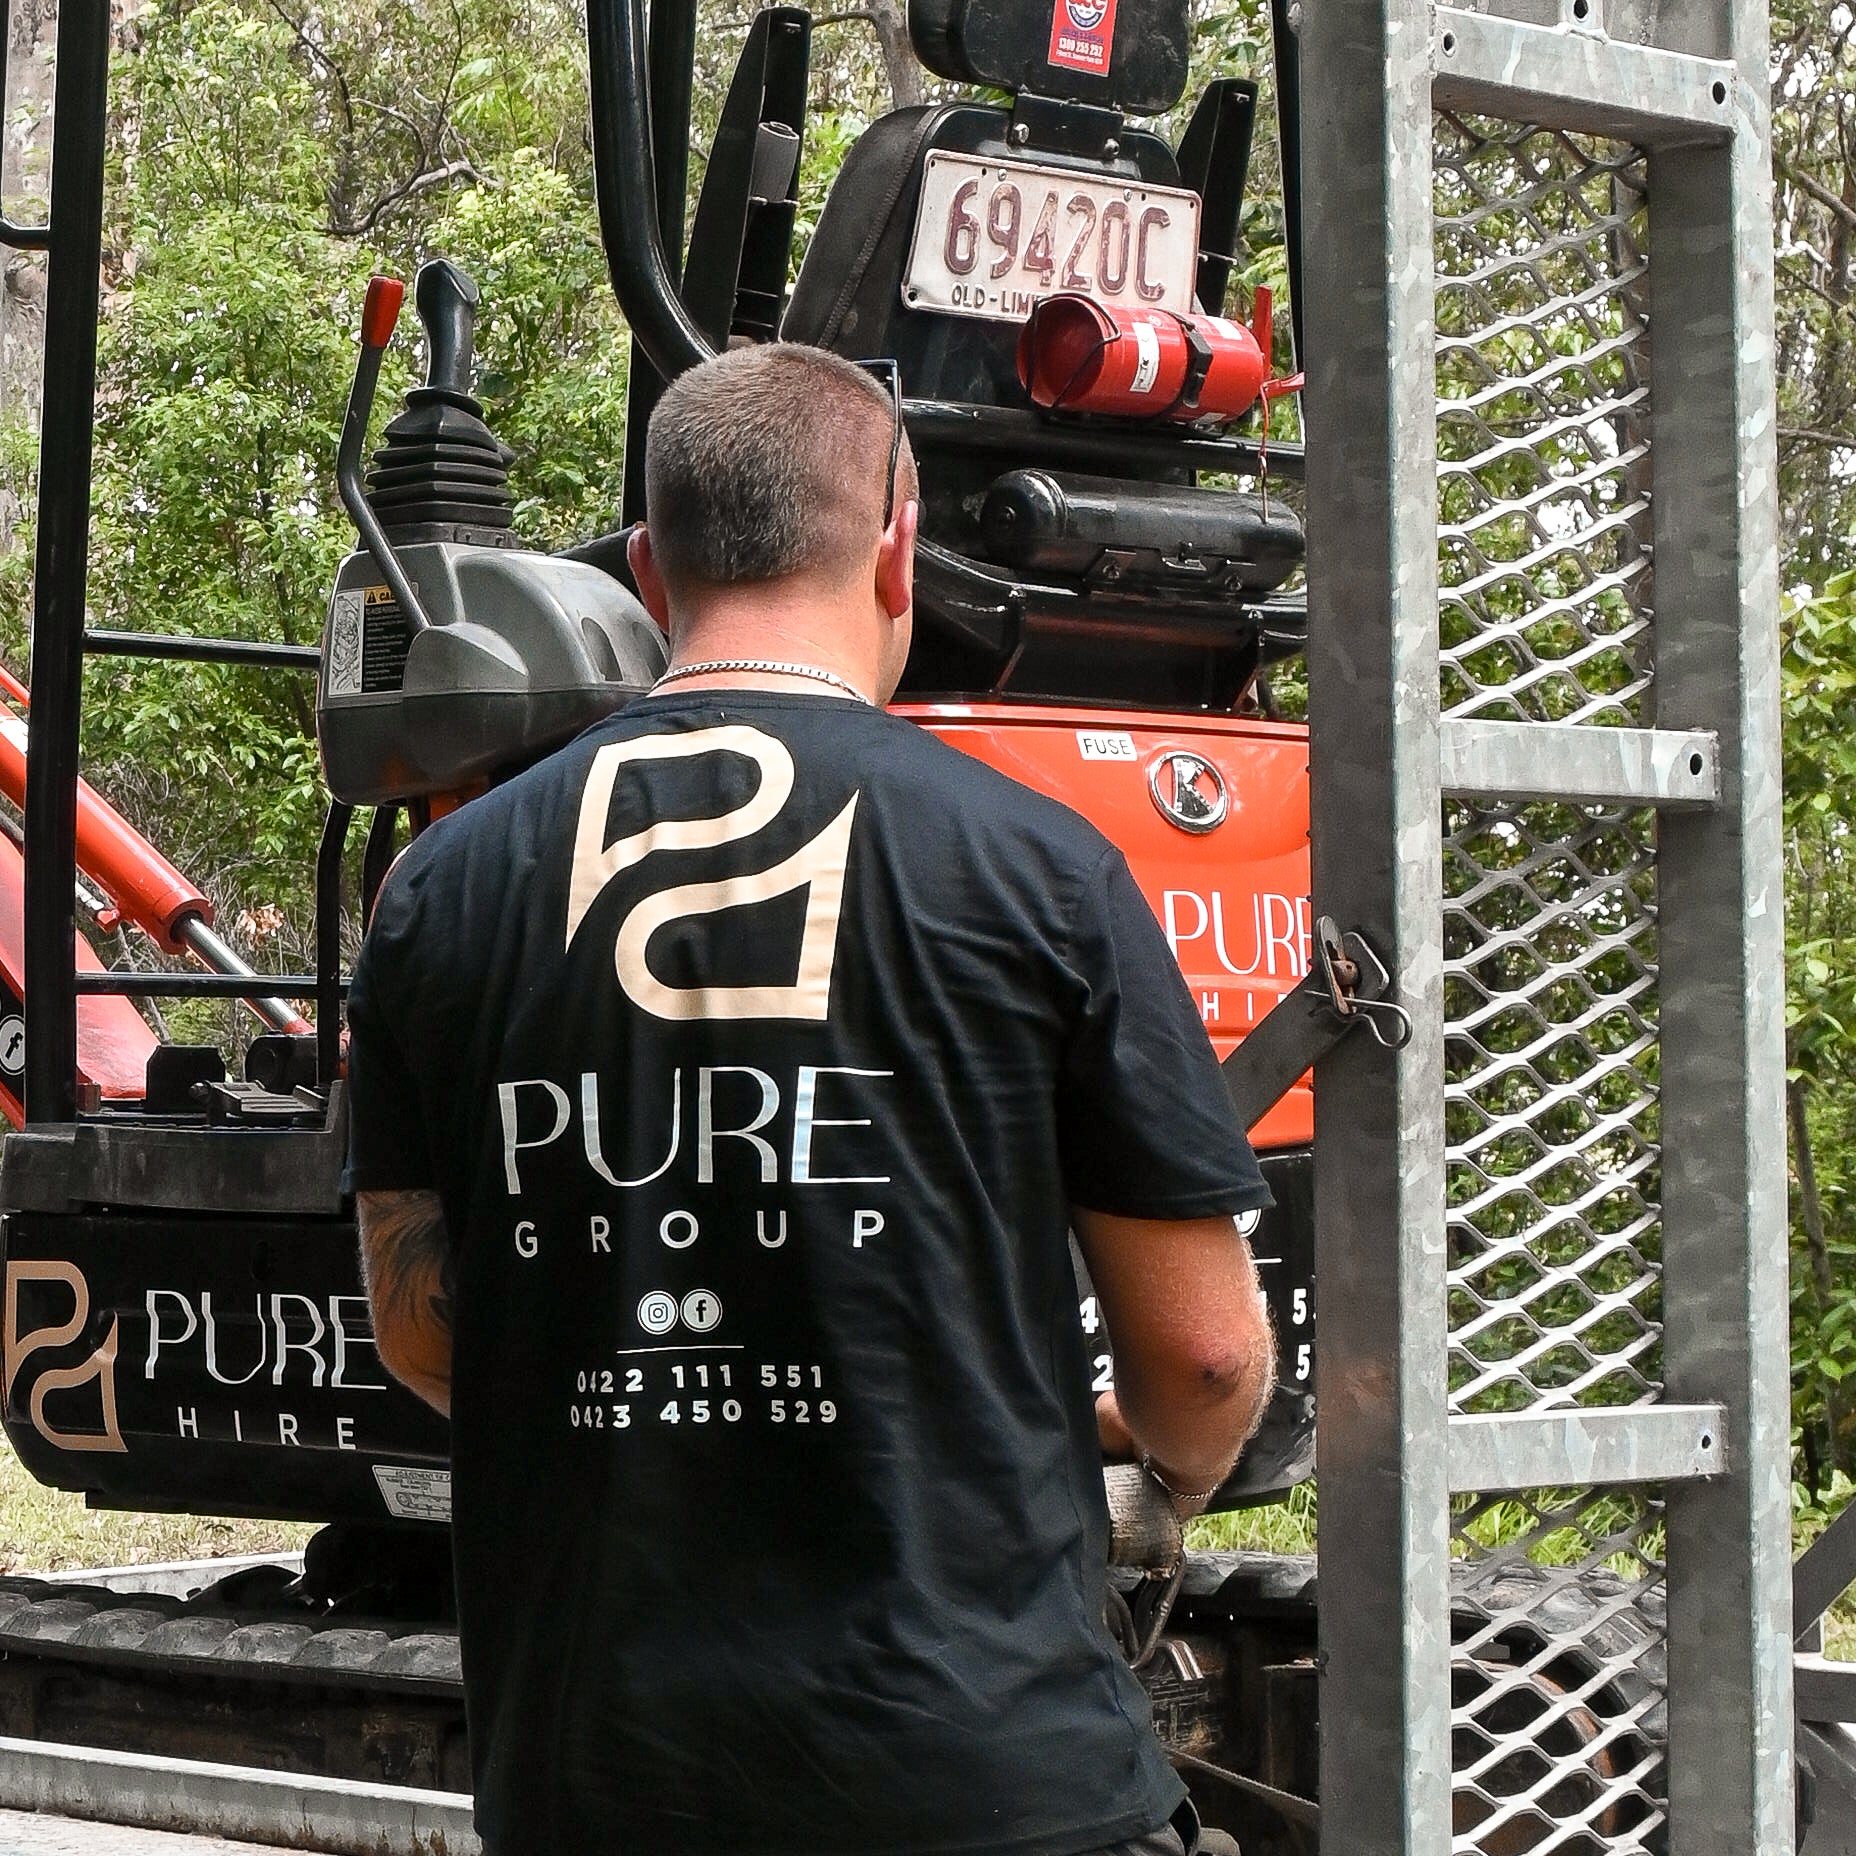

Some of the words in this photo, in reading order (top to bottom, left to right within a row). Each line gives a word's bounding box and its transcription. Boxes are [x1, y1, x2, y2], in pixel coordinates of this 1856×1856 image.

[944, 177, 1171, 301] 69420C
[1083, 738, 1132, 755] FUSE
[498, 1066, 894, 1194] PURE
[515, 1210, 885, 1258] GROUP
[145, 1290, 387, 1391] PURE
[672, 1365, 732, 1389] 111
[761, 1365, 822, 1388] 551
[177, 1406, 357, 1451] HIRE
[571, 1405, 631, 1429] 0423
[660, 1400, 743, 1424] 450
[771, 1400, 838, 1424] 529
